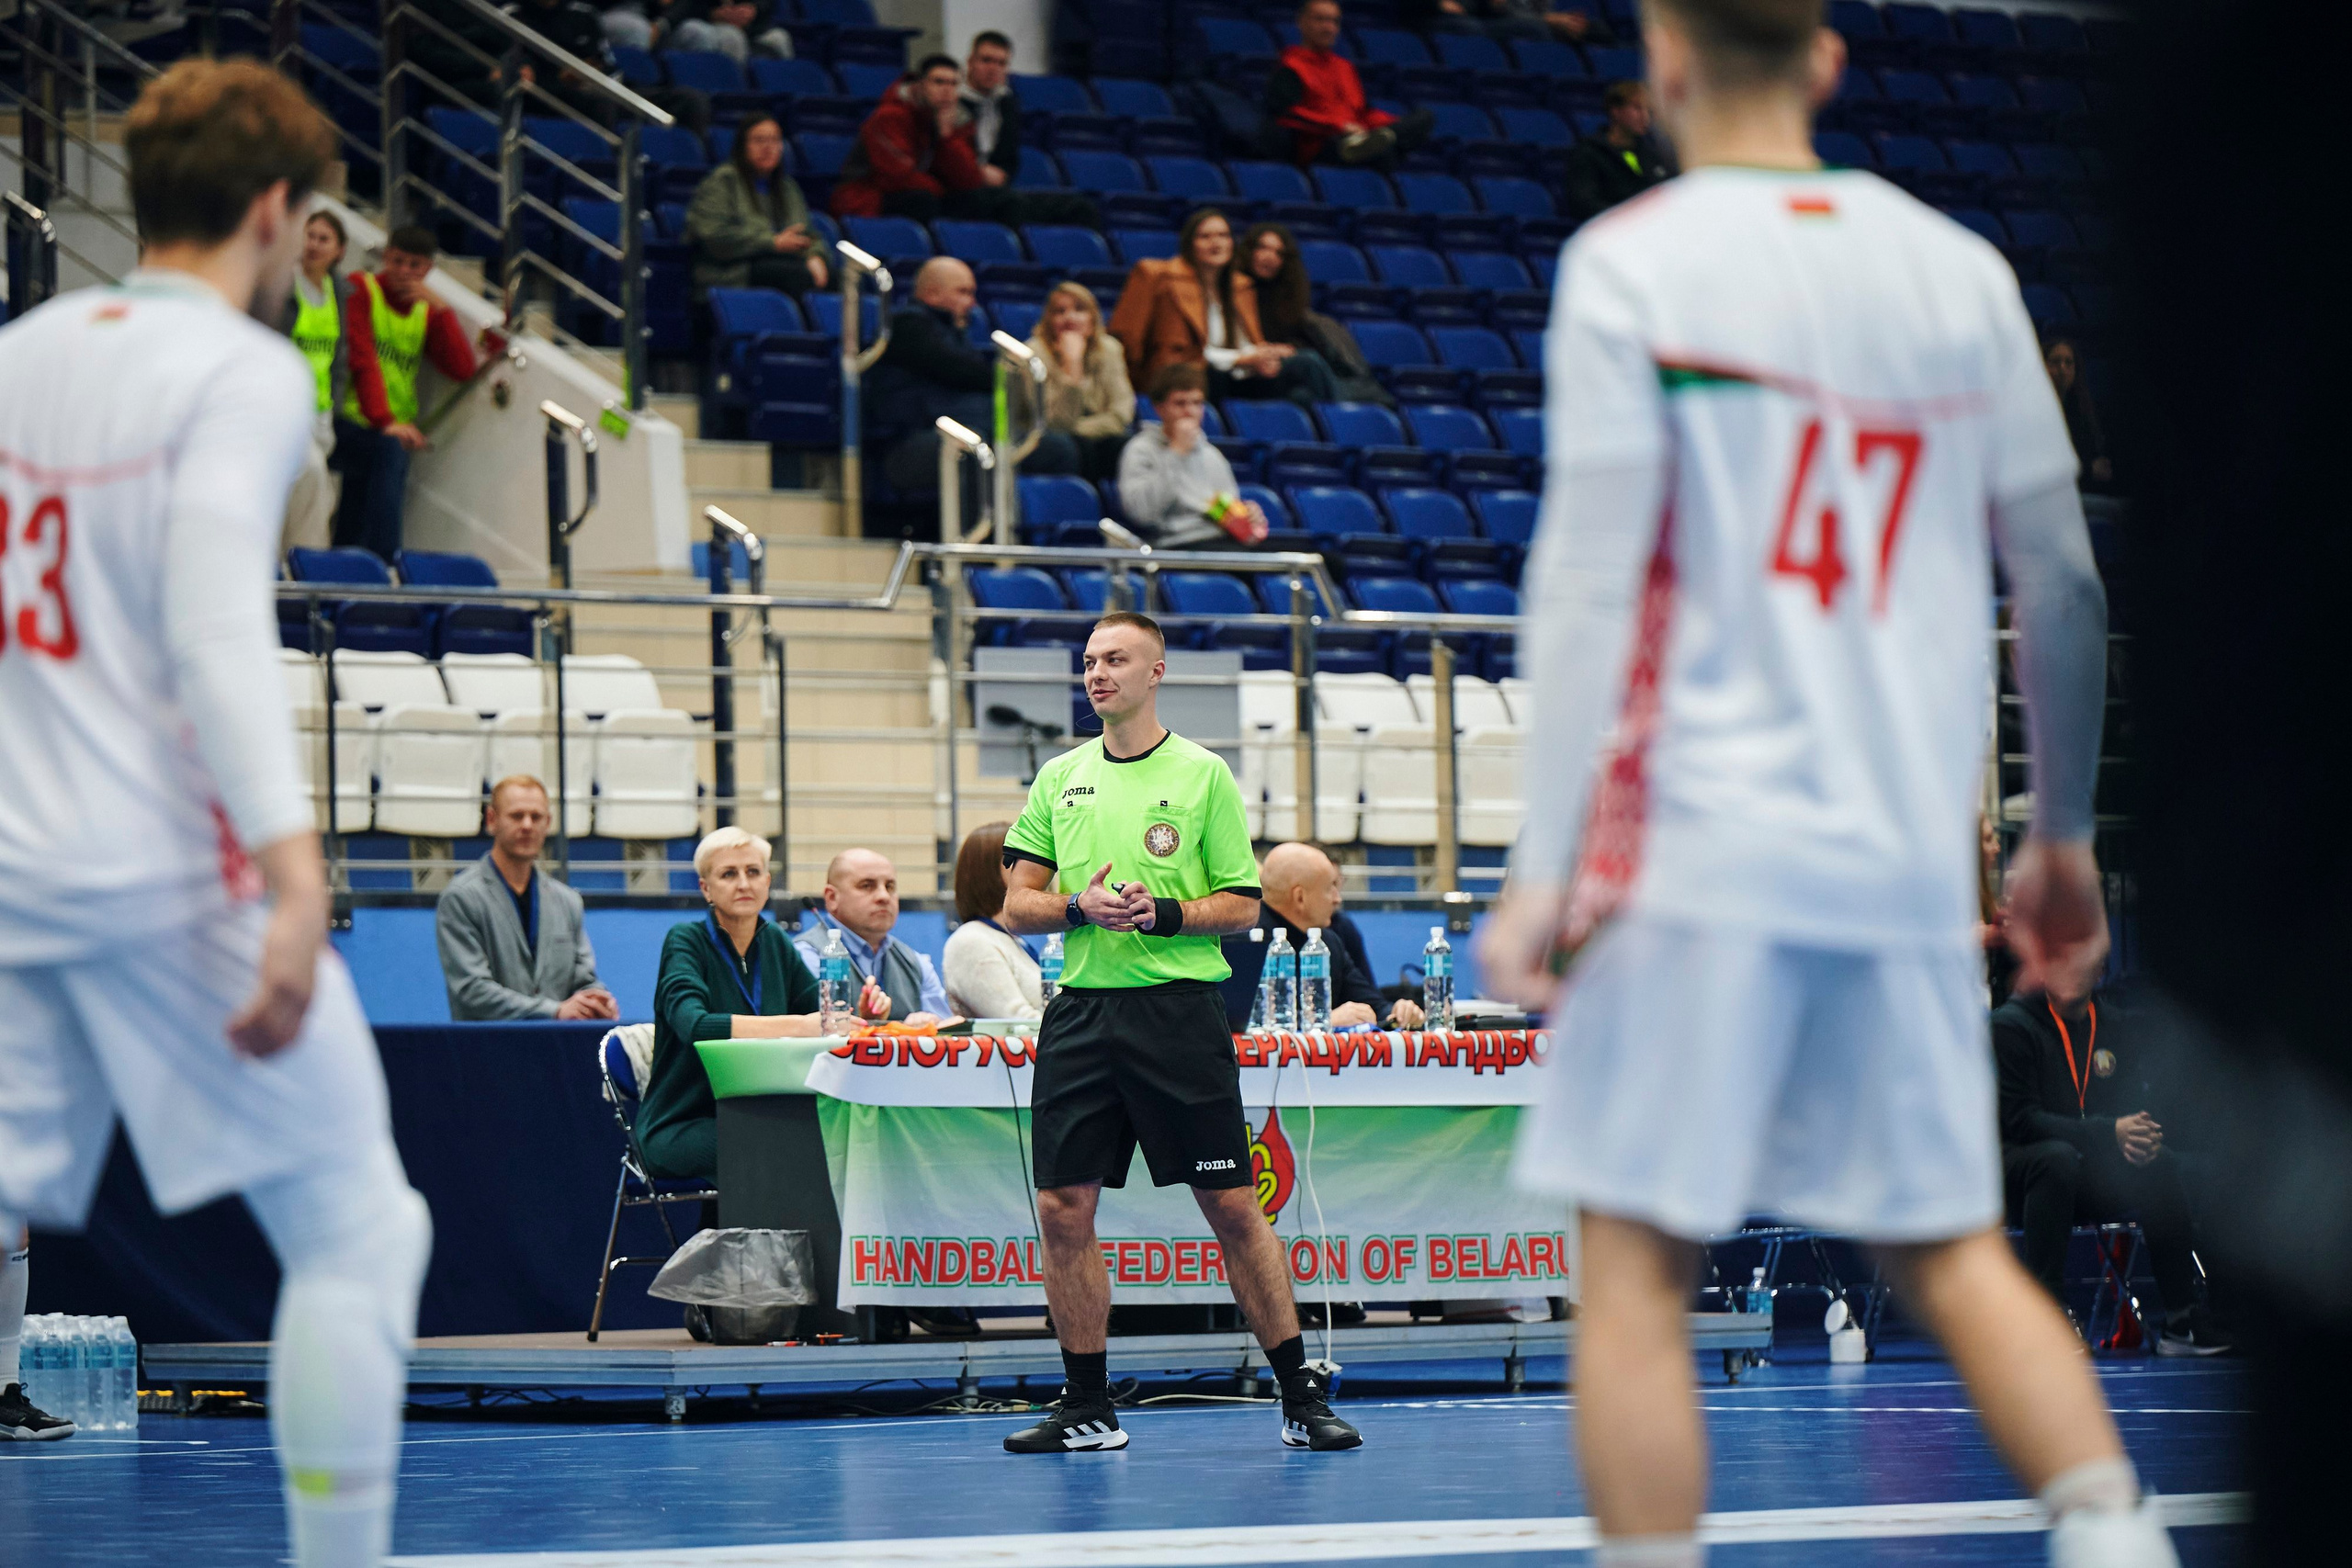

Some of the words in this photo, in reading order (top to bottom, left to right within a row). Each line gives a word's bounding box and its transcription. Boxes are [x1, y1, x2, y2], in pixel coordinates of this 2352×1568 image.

[1766, 415, 1924, 621] 47
[830, 1035, 1037, 1067] ЕЛОРУС
[1233, 1031, 1392, 1076] ЕРАЦИЯ
[1401, 1030, 1555, 1075] ГАНДБО
[851, 1236, 1045, 1287] HANDBAL
[1361, 1235, 1417, 1284] OF
